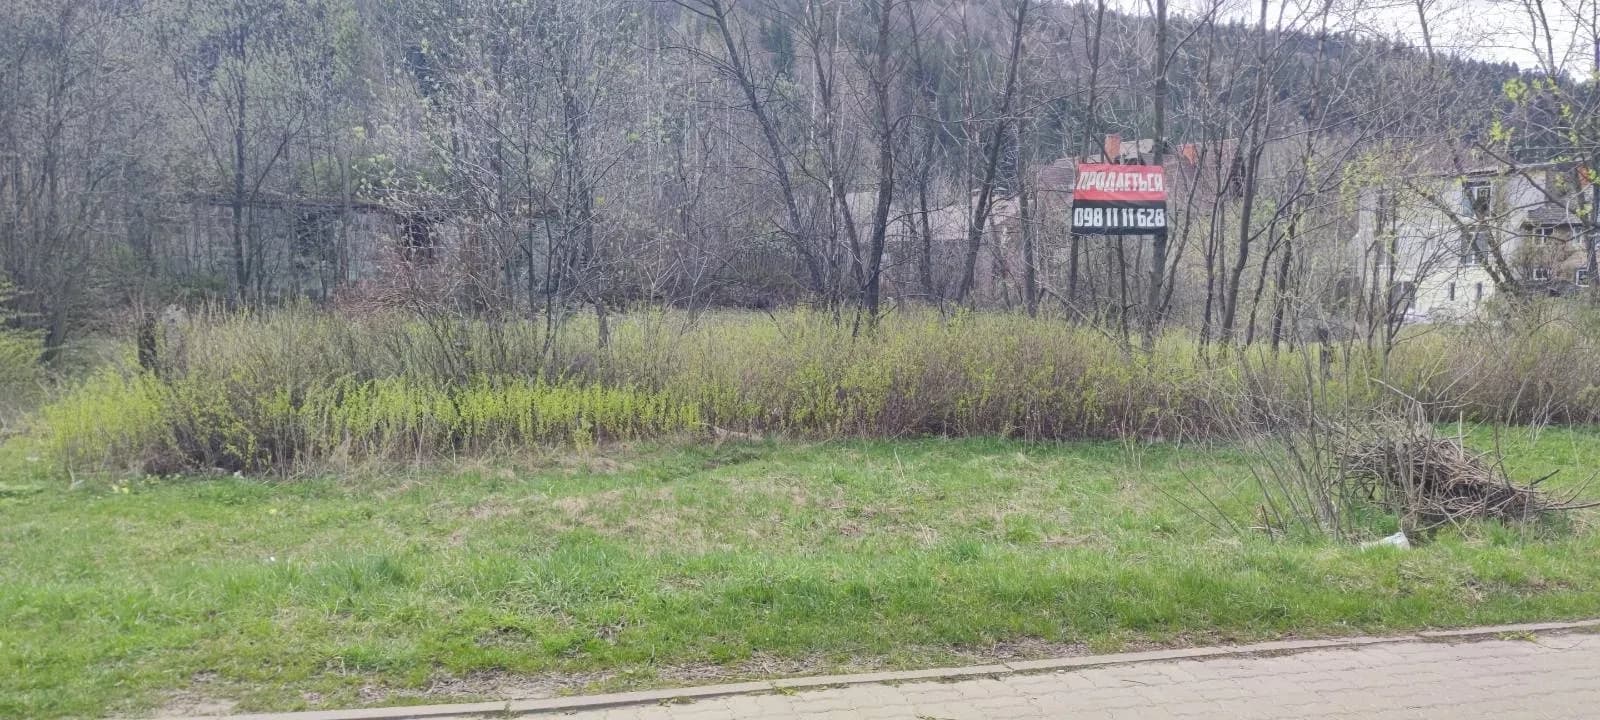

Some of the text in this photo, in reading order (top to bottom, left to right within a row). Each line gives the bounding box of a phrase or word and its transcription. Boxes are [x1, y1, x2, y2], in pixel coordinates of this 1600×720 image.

[1073, 207, 1165, 227] 098 11 11 628
